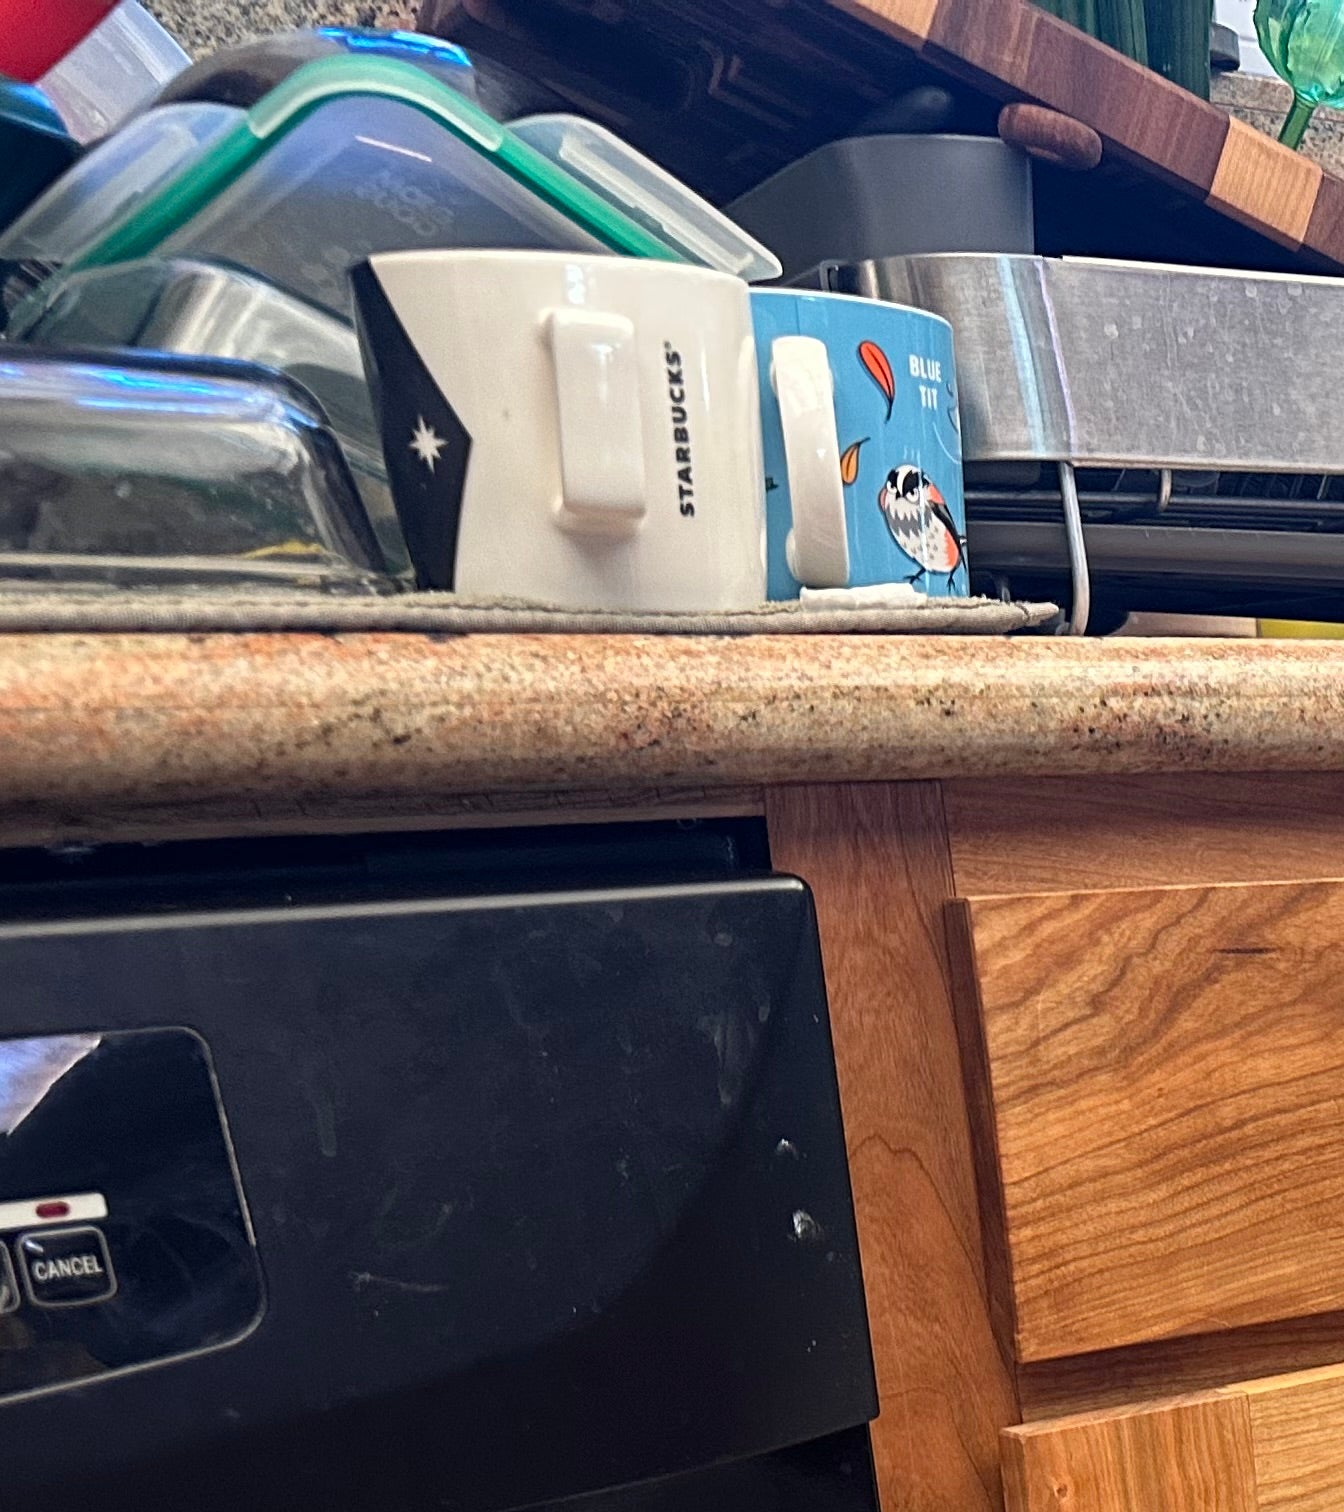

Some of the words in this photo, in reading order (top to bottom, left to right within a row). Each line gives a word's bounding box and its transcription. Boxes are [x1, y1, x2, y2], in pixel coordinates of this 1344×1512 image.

[908, 354, 942, 381] BLUE
[919, 385, 938, 409] TIT
[664, 346, 695, 518] STARBUCKS
[34, 1255, 103, 1281] CANCEL
